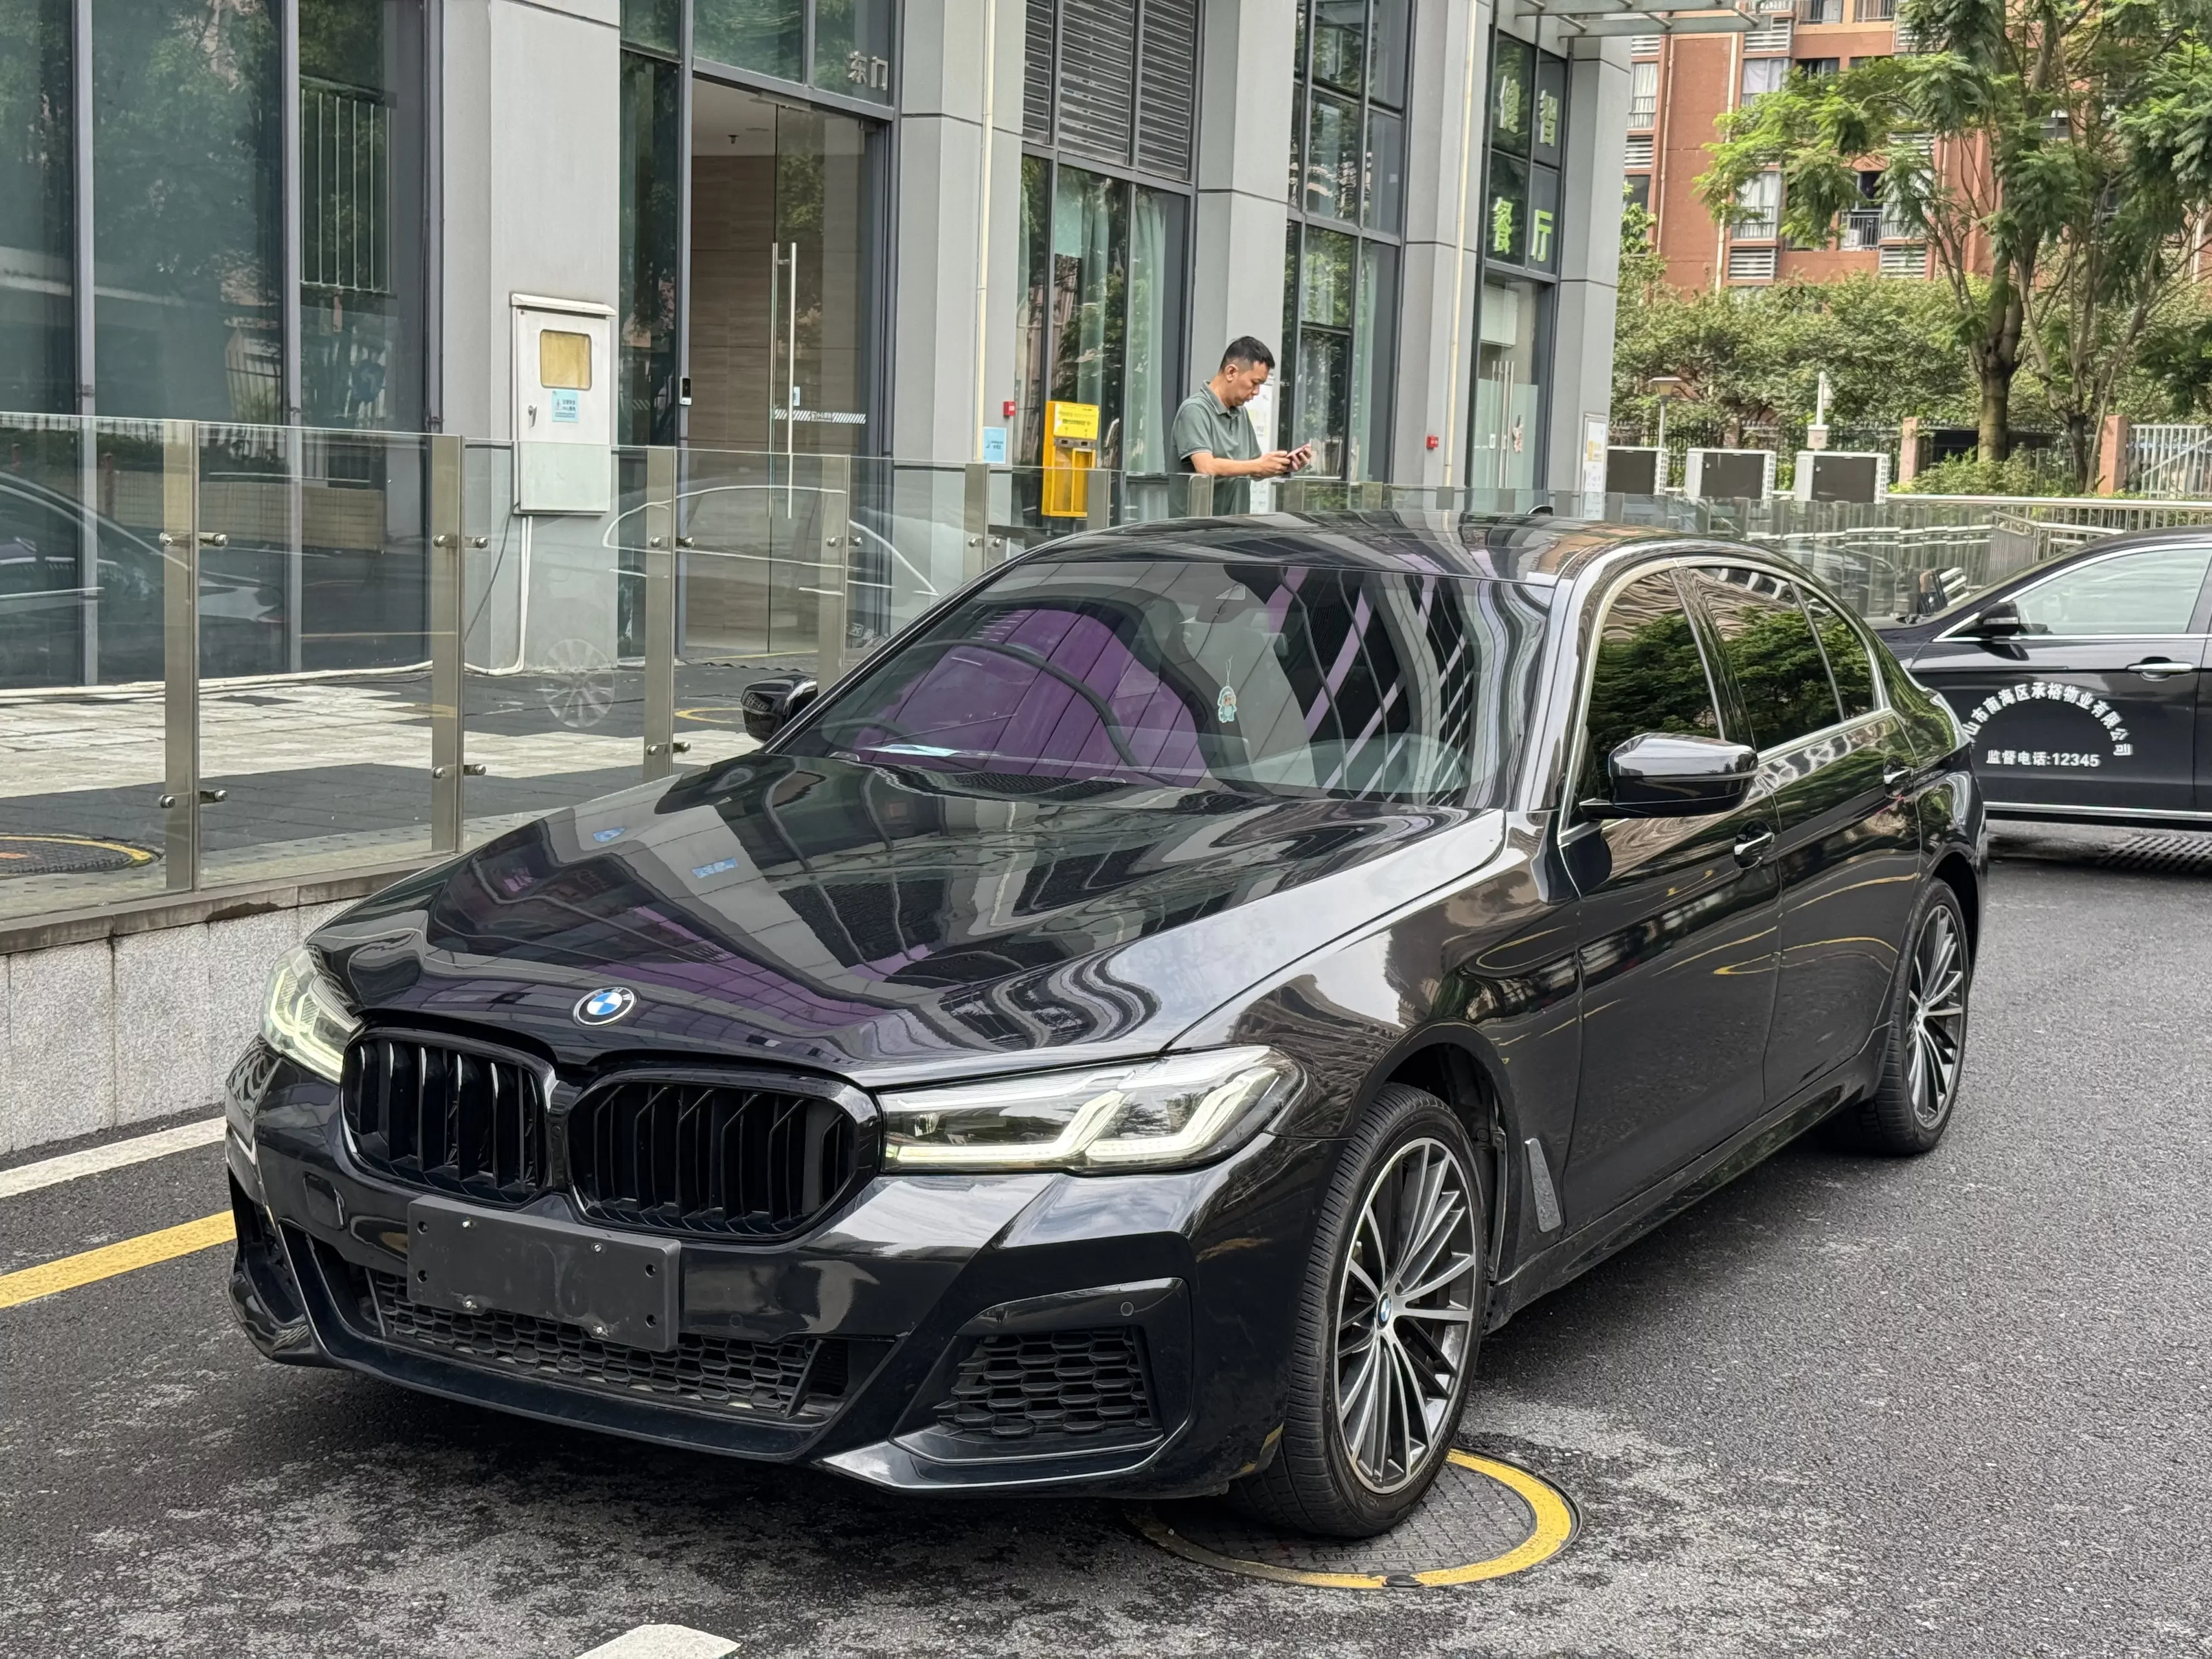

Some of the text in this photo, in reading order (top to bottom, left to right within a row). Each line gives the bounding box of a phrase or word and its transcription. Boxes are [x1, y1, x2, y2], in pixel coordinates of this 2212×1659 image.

[848, 51, 888, 91] 东门
[1492, 196, 1554, 262] 餐厅
[1962, 681, 2134, 757] 山市南海区承裕物业有限公司
[1986, 749, 2101, 768] 监督电话:12345
